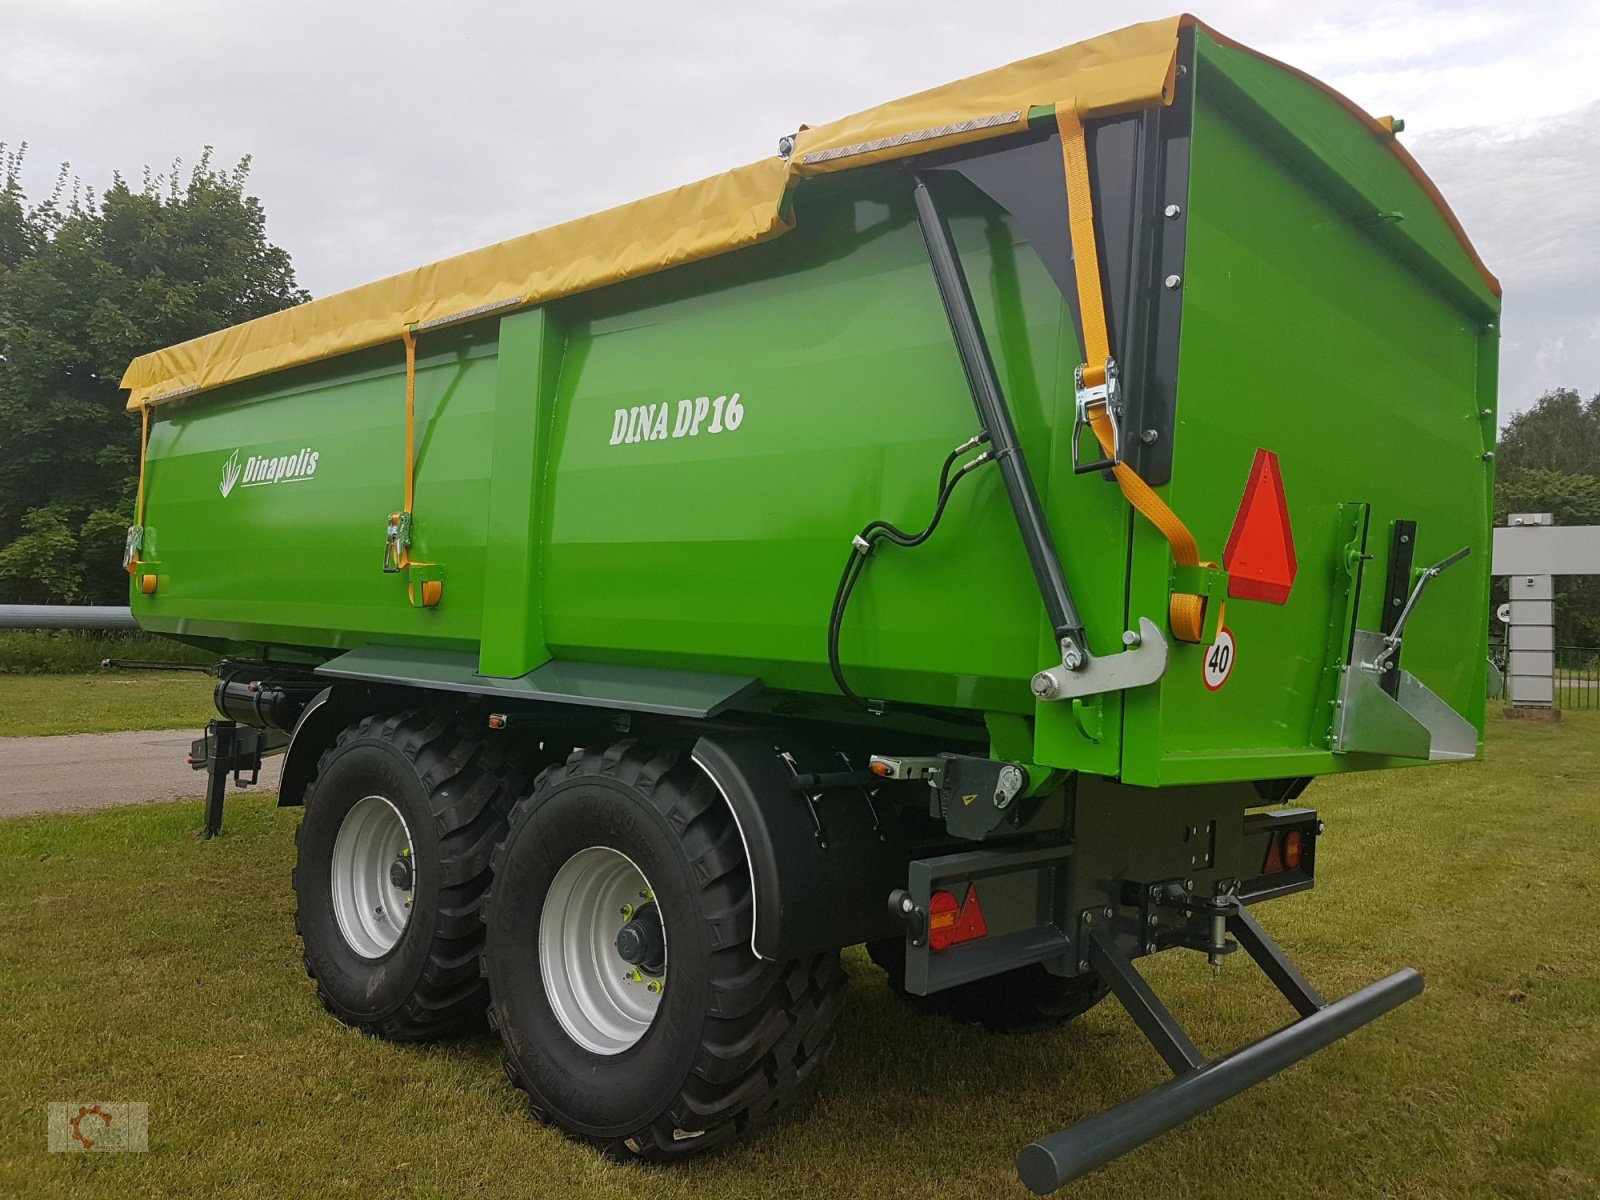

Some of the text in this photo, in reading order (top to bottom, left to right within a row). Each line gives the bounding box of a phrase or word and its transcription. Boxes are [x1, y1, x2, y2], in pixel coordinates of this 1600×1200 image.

[609, 401, 668, 445] DINA
[242, 447, 319, 483] Dinapolis
[1208, 644, 1230, 673] 40
